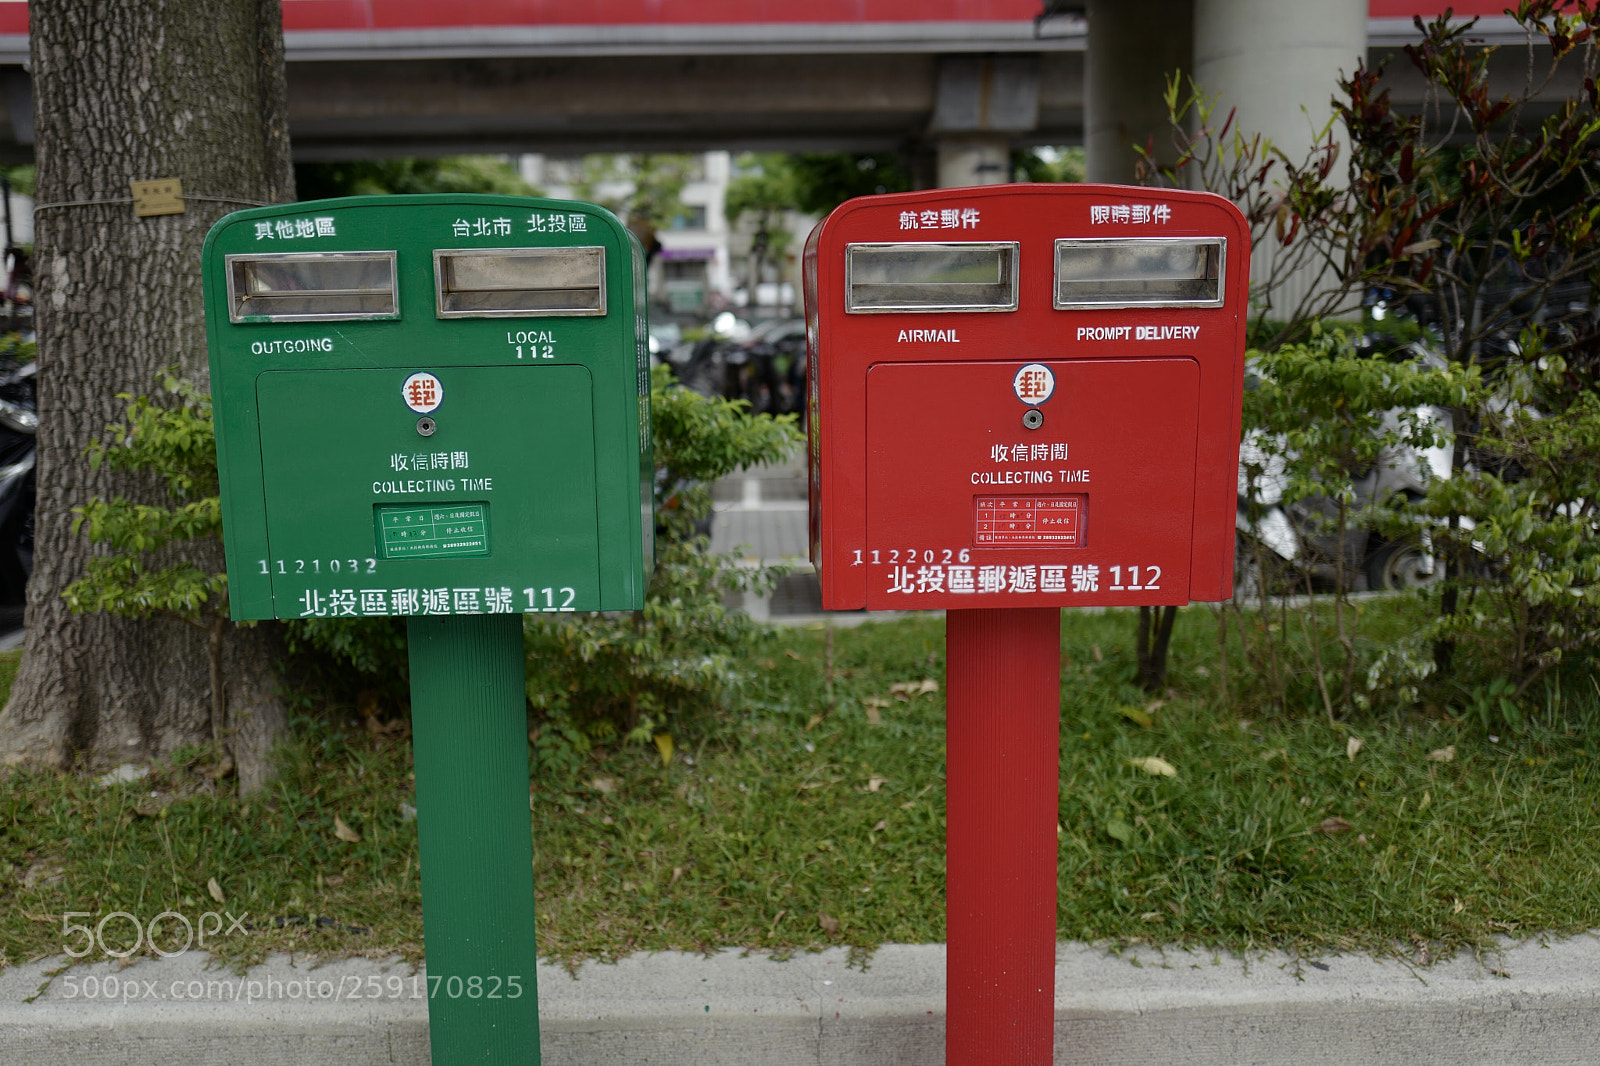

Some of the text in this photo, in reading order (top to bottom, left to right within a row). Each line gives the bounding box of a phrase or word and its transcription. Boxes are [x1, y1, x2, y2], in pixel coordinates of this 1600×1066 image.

[899, 208, 981, 230] 航空郵件
[1090, 204, 1171, 225] 限時郵件
[254, 217, 336, 240] 其他地區
[452, 214, 587, 238] 台北市 北投區
[507, 331, 557, 345] LOCAL
[897, 329, 960, 343] AIRMAIL
[1076, 325, 1201, 341] PROMPT DELIVERY
[251, 338, 333, 355] OUTGOING
[515, 345, 555, 360] 112
[390, 451, 469, 472] 收信時間
[990, 443, 1069, 463] 收信時間
[372, 478, 493, 494] COLLECTING TIME
[970, 469, 1091, 485] COLLECTING TIME
[852, 548, 970, 566] 1122026
[258, 558, 377, 575] 1121032
[886, 564, 1162, 594] 北投區郵遞區號 112
[299, 587, 576, 618] 北投區郵遞區號 112
